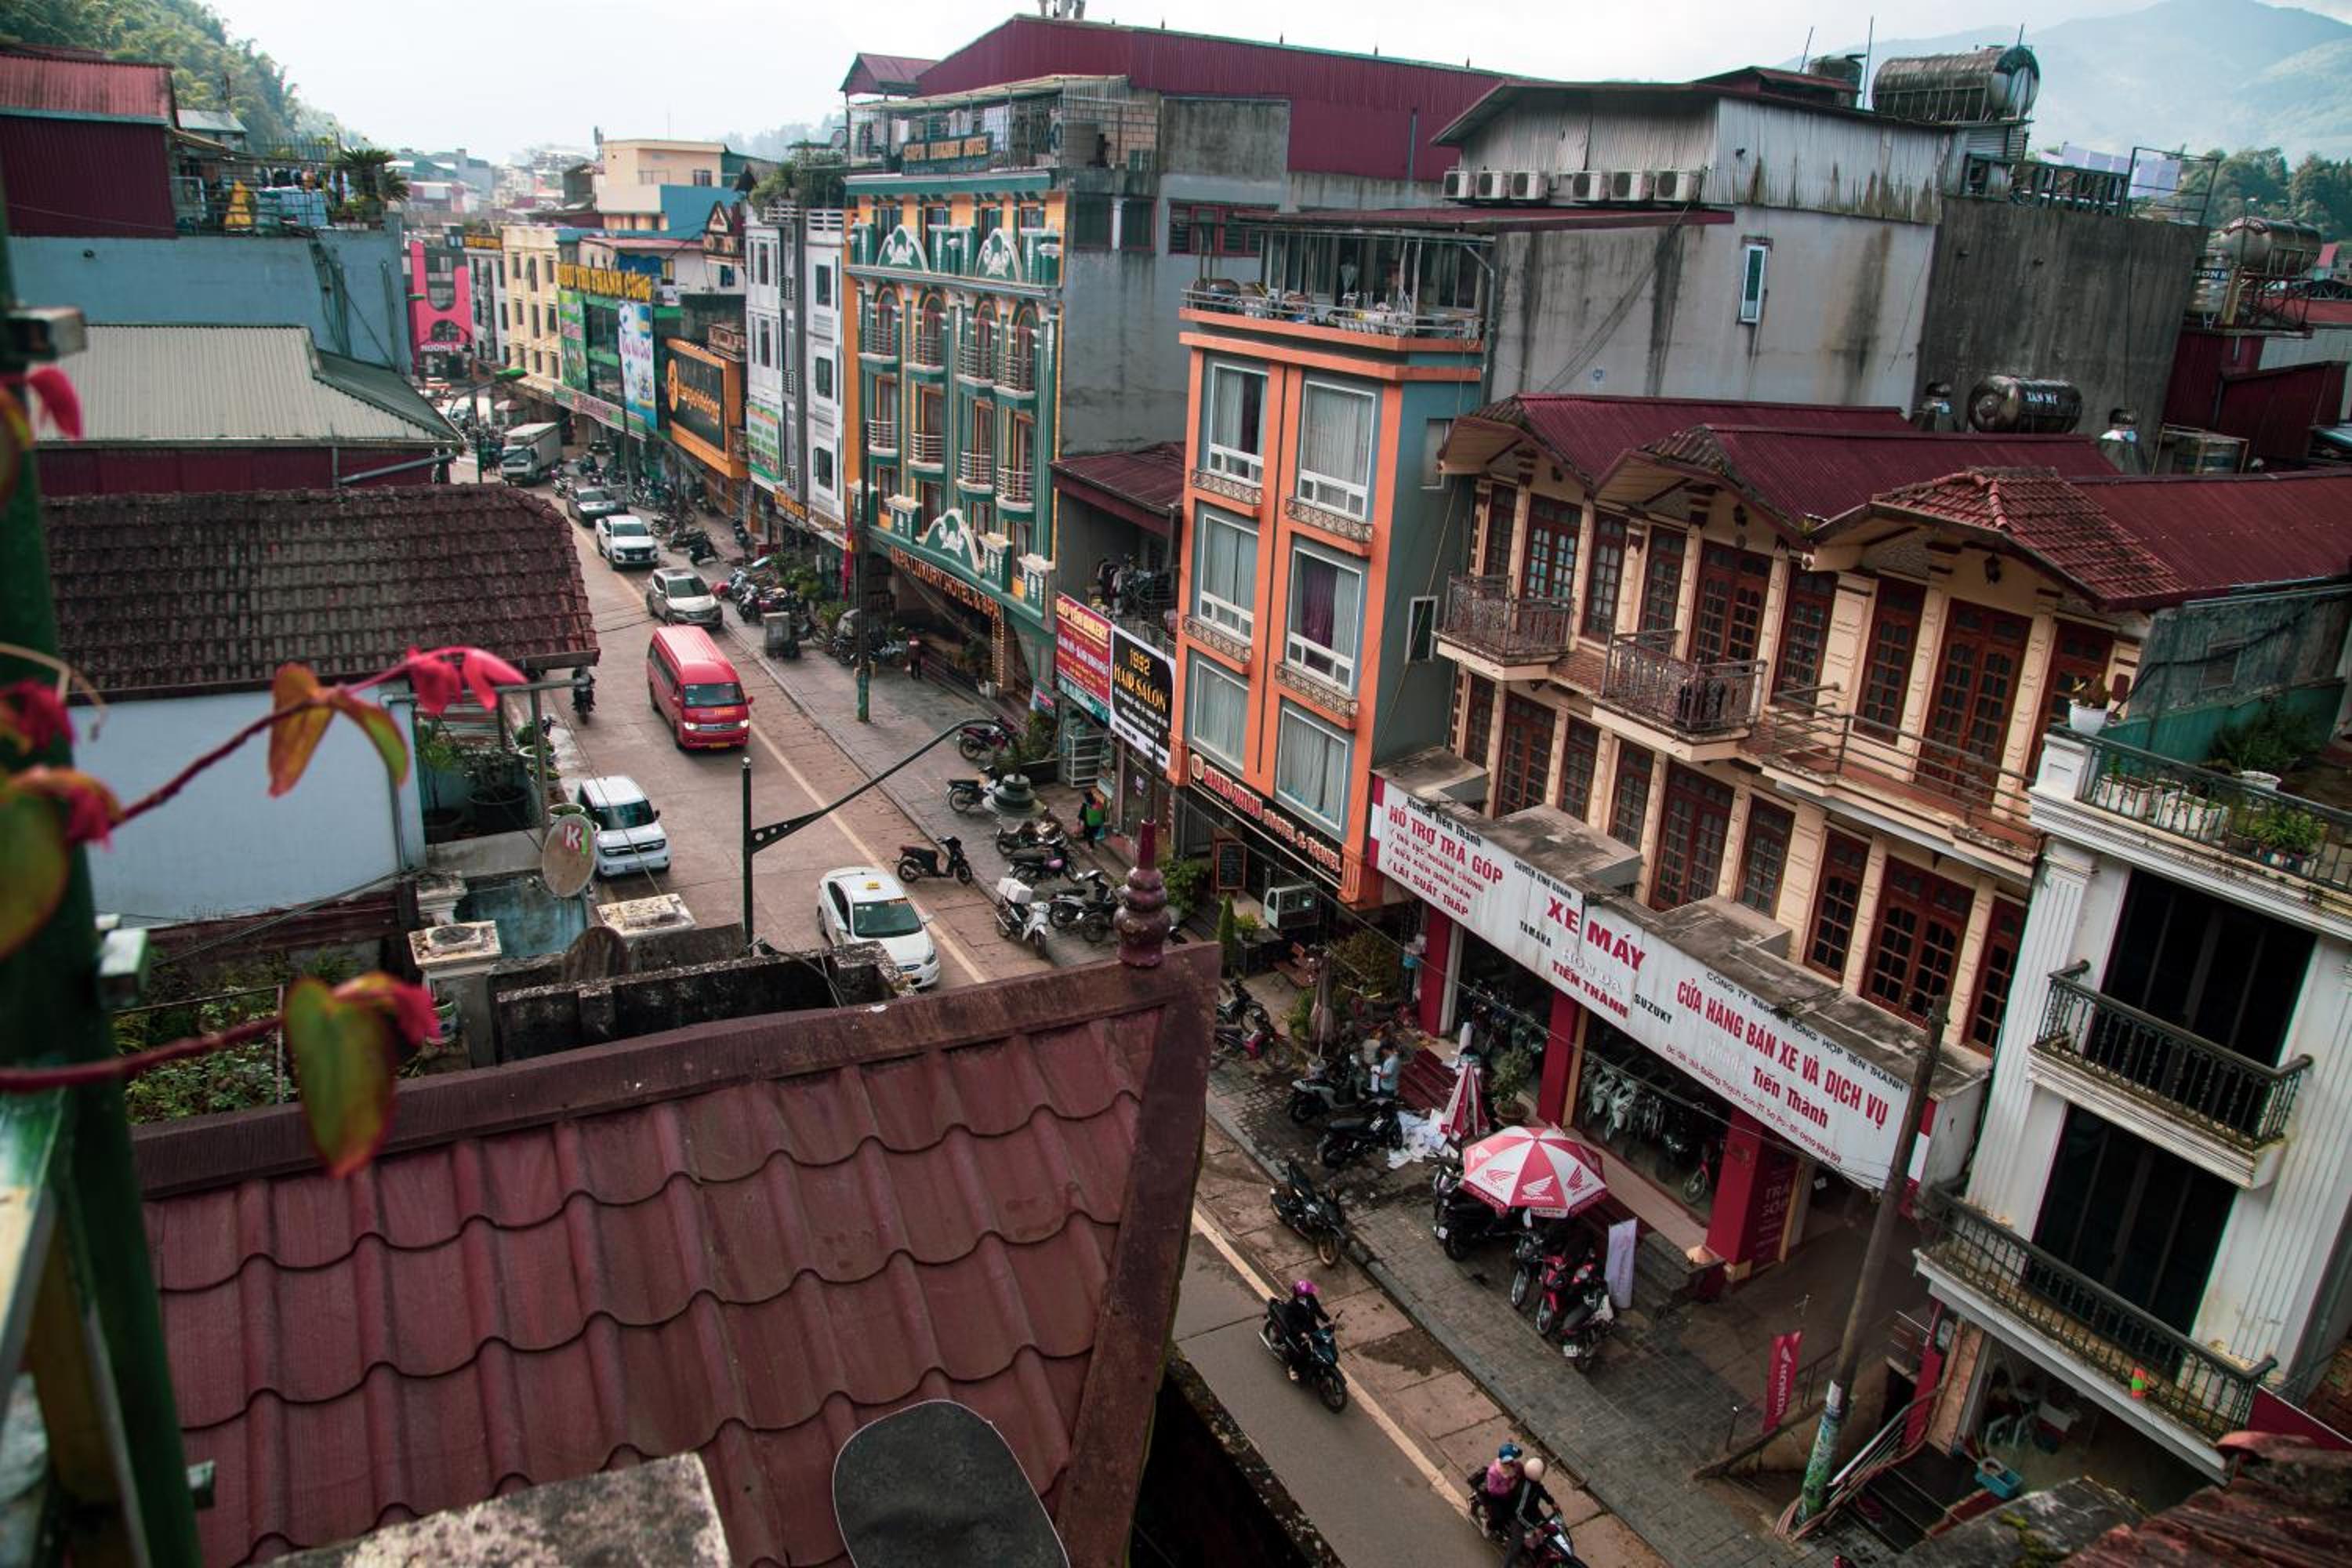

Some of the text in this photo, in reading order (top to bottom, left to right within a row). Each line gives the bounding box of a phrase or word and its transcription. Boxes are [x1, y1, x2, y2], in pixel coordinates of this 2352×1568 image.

[1136, 679, 1166, 713] SALON
[1410, 817, 1436, 848] TRỢ
[1440, 834, 1466, 866] TRẢ
[1472, 851, 1504, 885] GÓP
[1547, 896, 1646, 972] XE MÁY
[1584, 980, 1628, 1019] THÀNH
[1677, 978, 1702, 1014] CỬA
[1705, 997, 1744, 1040] HÀNG
[1746, 1024, 1777, 1058] BÁN
[1777, 1040, 1798, 1073] XE
[1803, 1054, 1819, 1087] VÀ
[1824, 1069, 1863, 1111] DỊCH
[1865, 1093, 1889, 1131] VỤ
[1752, 1065, 1781, 1099] Tiến
[1786, 1085, 1830, 1129] Thành
